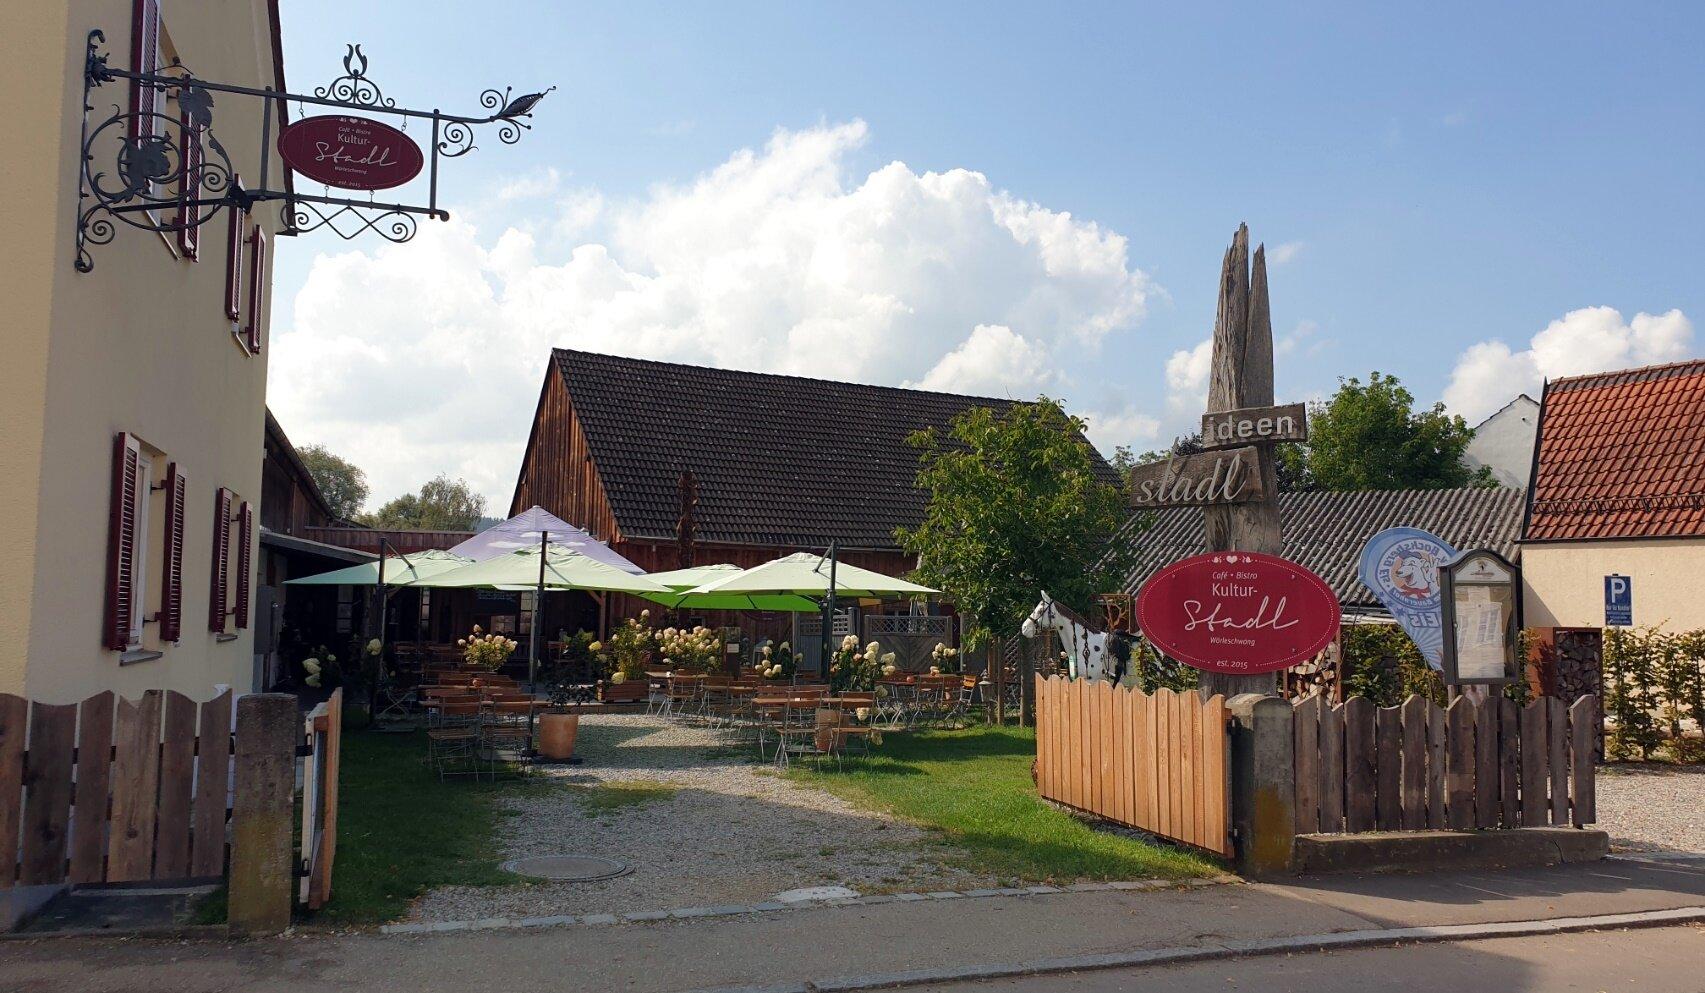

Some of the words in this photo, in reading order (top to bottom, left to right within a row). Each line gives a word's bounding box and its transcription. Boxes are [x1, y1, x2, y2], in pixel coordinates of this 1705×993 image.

[338, 133, 371, 145] Kultur-
[315, 141, 397, 167] Stadl
[1204, 415, 1293, 442] ideen
[1137, 436, 1247, 503] stadl
[1212, 571, 1228, 580] Café
[1236, 571, 1258, 580] Bistro
[1212, 582, 1258, 597] Kultur-
[1611, 578, 1626, 604] P
[1184, 596, 1299, 632] Stadl
[1210, 636, 1256, 647] Wörleschwang
[1216, 659, 1230, 668] est.
[1230, 660, 1248, 670] 2015
